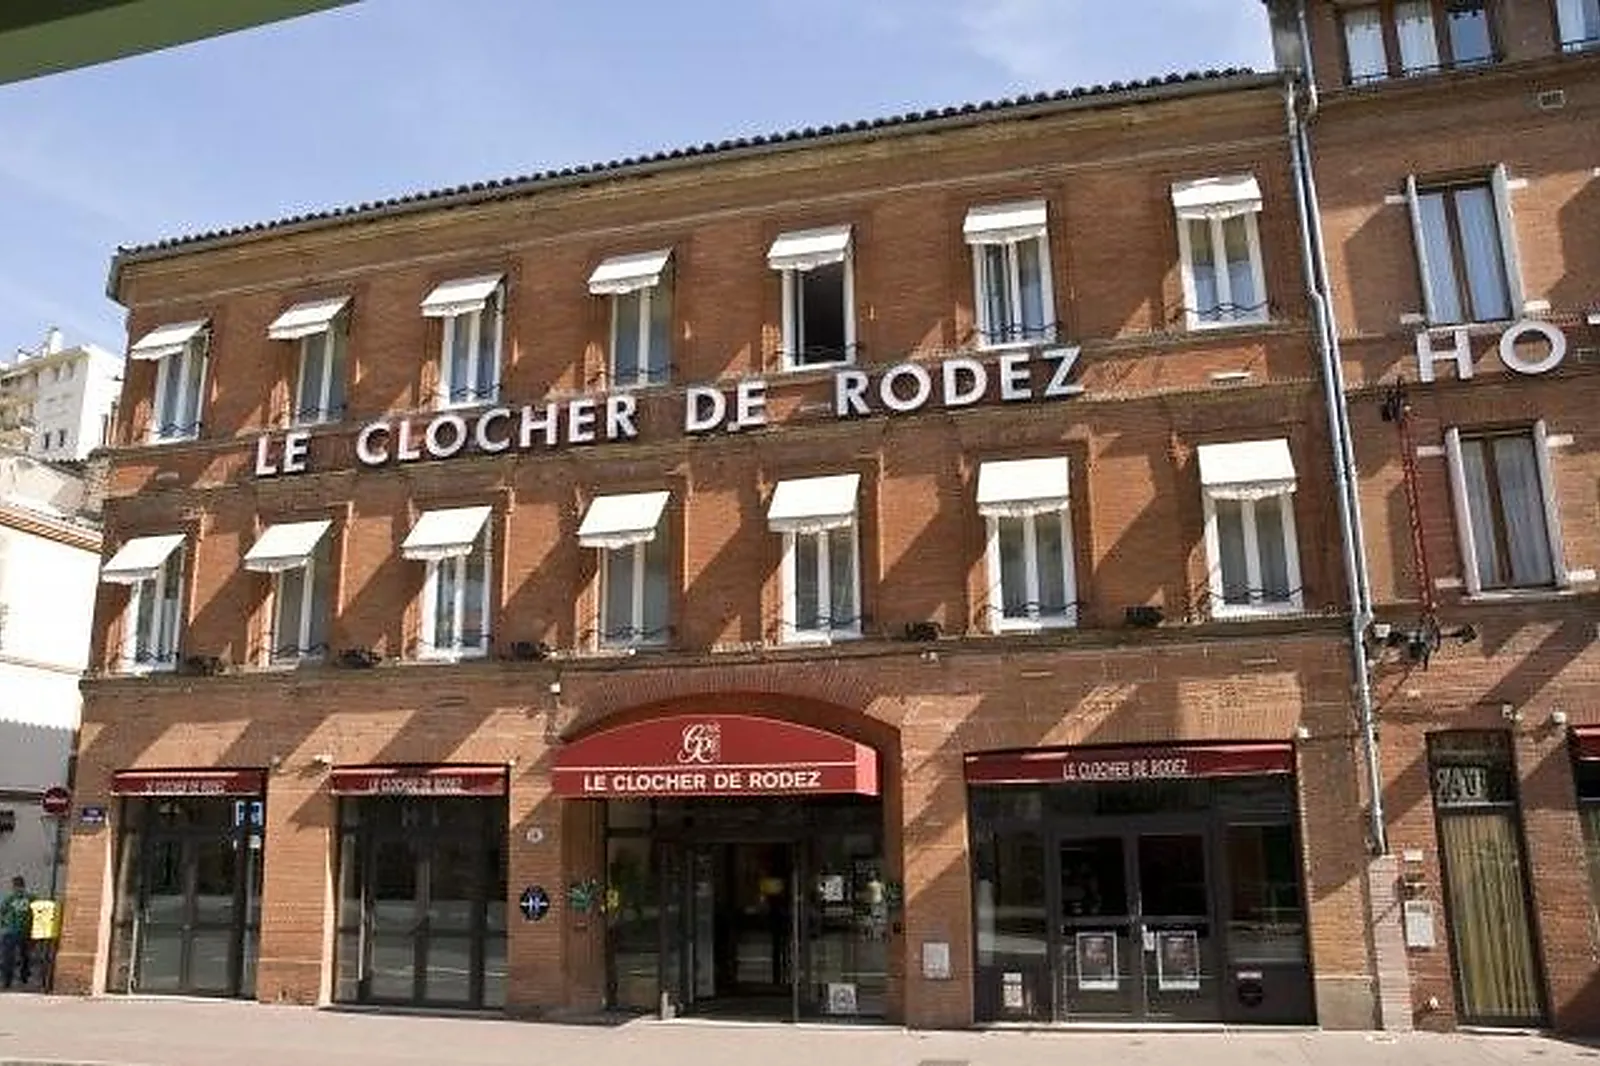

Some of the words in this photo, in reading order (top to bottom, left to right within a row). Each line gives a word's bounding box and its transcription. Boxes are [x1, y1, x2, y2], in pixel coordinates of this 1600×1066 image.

[1416, 320, 1600, 382] HO
[255, 432, 312, 476] LE
[356, 395, 639, 467] CLOCHER
[685, 381, 767, 431] DE
[836, 346, 1085, 416] RODEZ
[583, 774, 608, 792] LE
[613, 773, 706, 791] CLOCHER
[714, 772, 742, 789] DE
[749, 770, 822, 789] RODEZ
